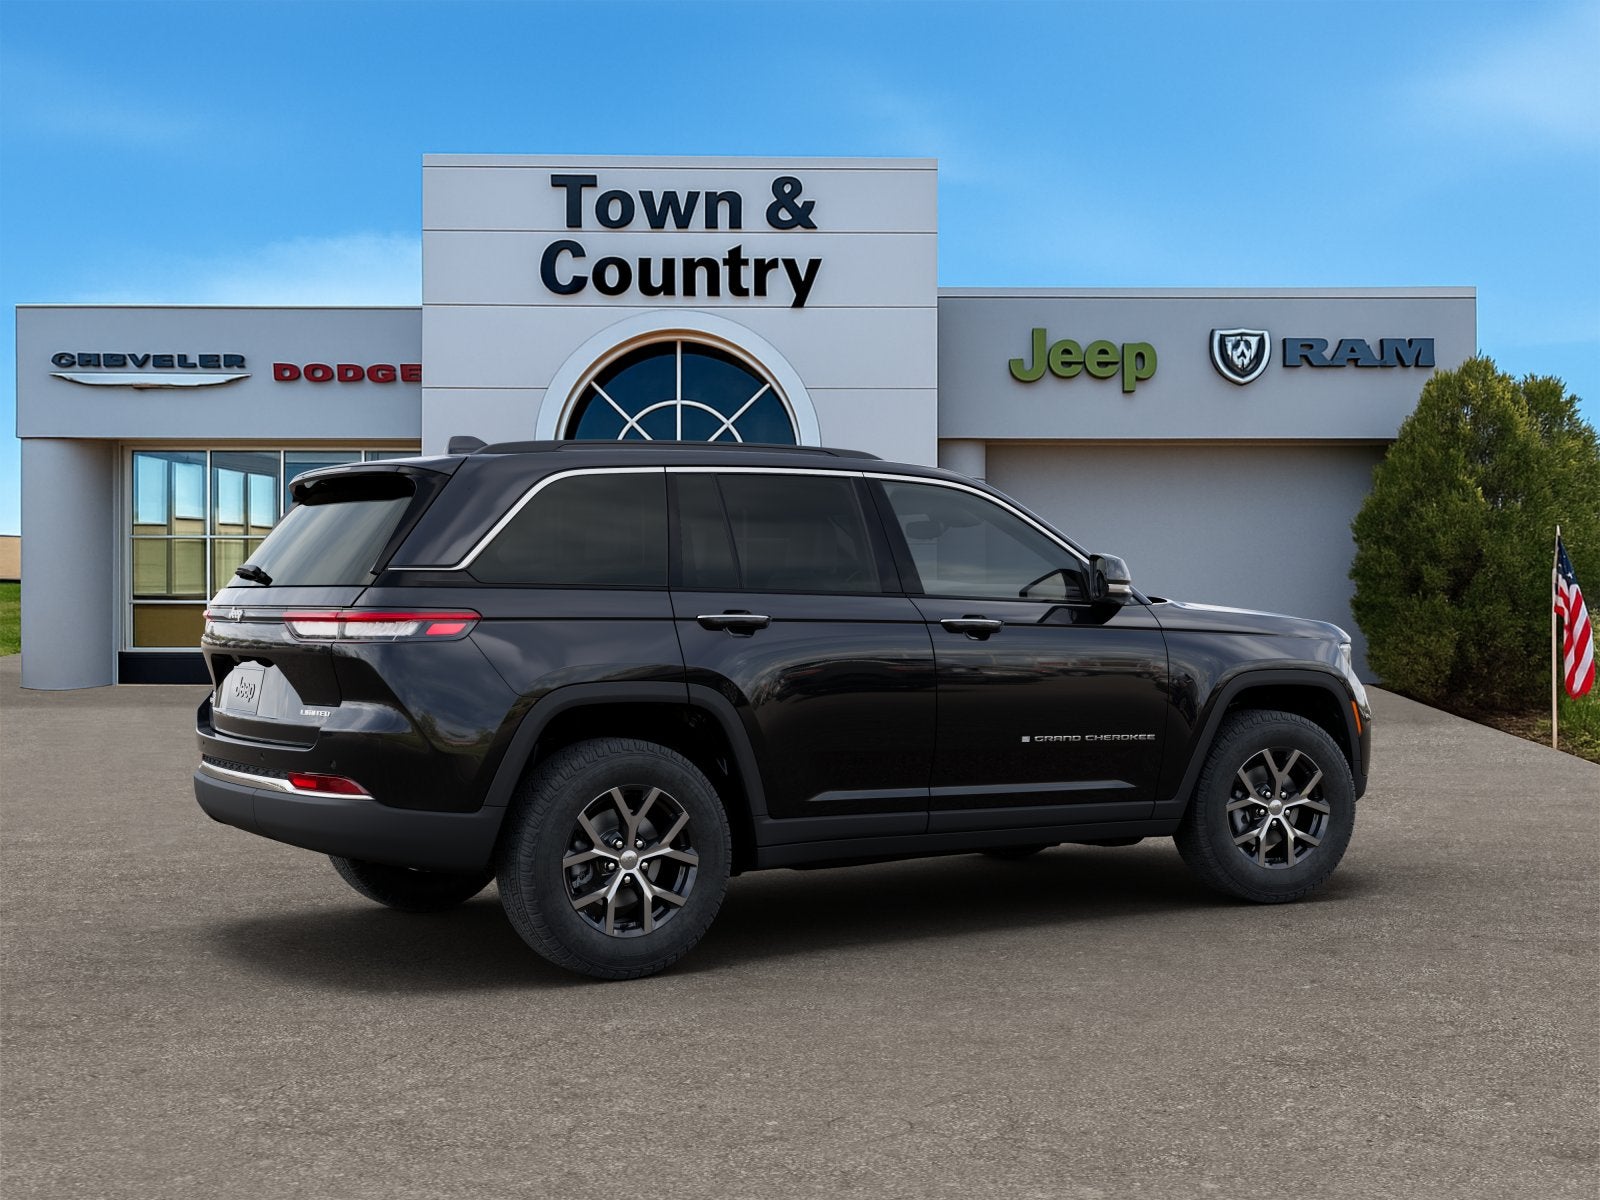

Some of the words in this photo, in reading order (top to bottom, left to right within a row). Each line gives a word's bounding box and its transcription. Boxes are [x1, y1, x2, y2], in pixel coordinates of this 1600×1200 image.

[551, 174, 742, 229] Town
[765, 176, 818, 230] &
[540, 239, 822, 308] Country
[273, 363, 422, 383] DODGE
[1009, 328, 1157, 393] Jeep
[1283, 338, 1435, 367] RAM
[235, 676, 256, 703] Jeep
